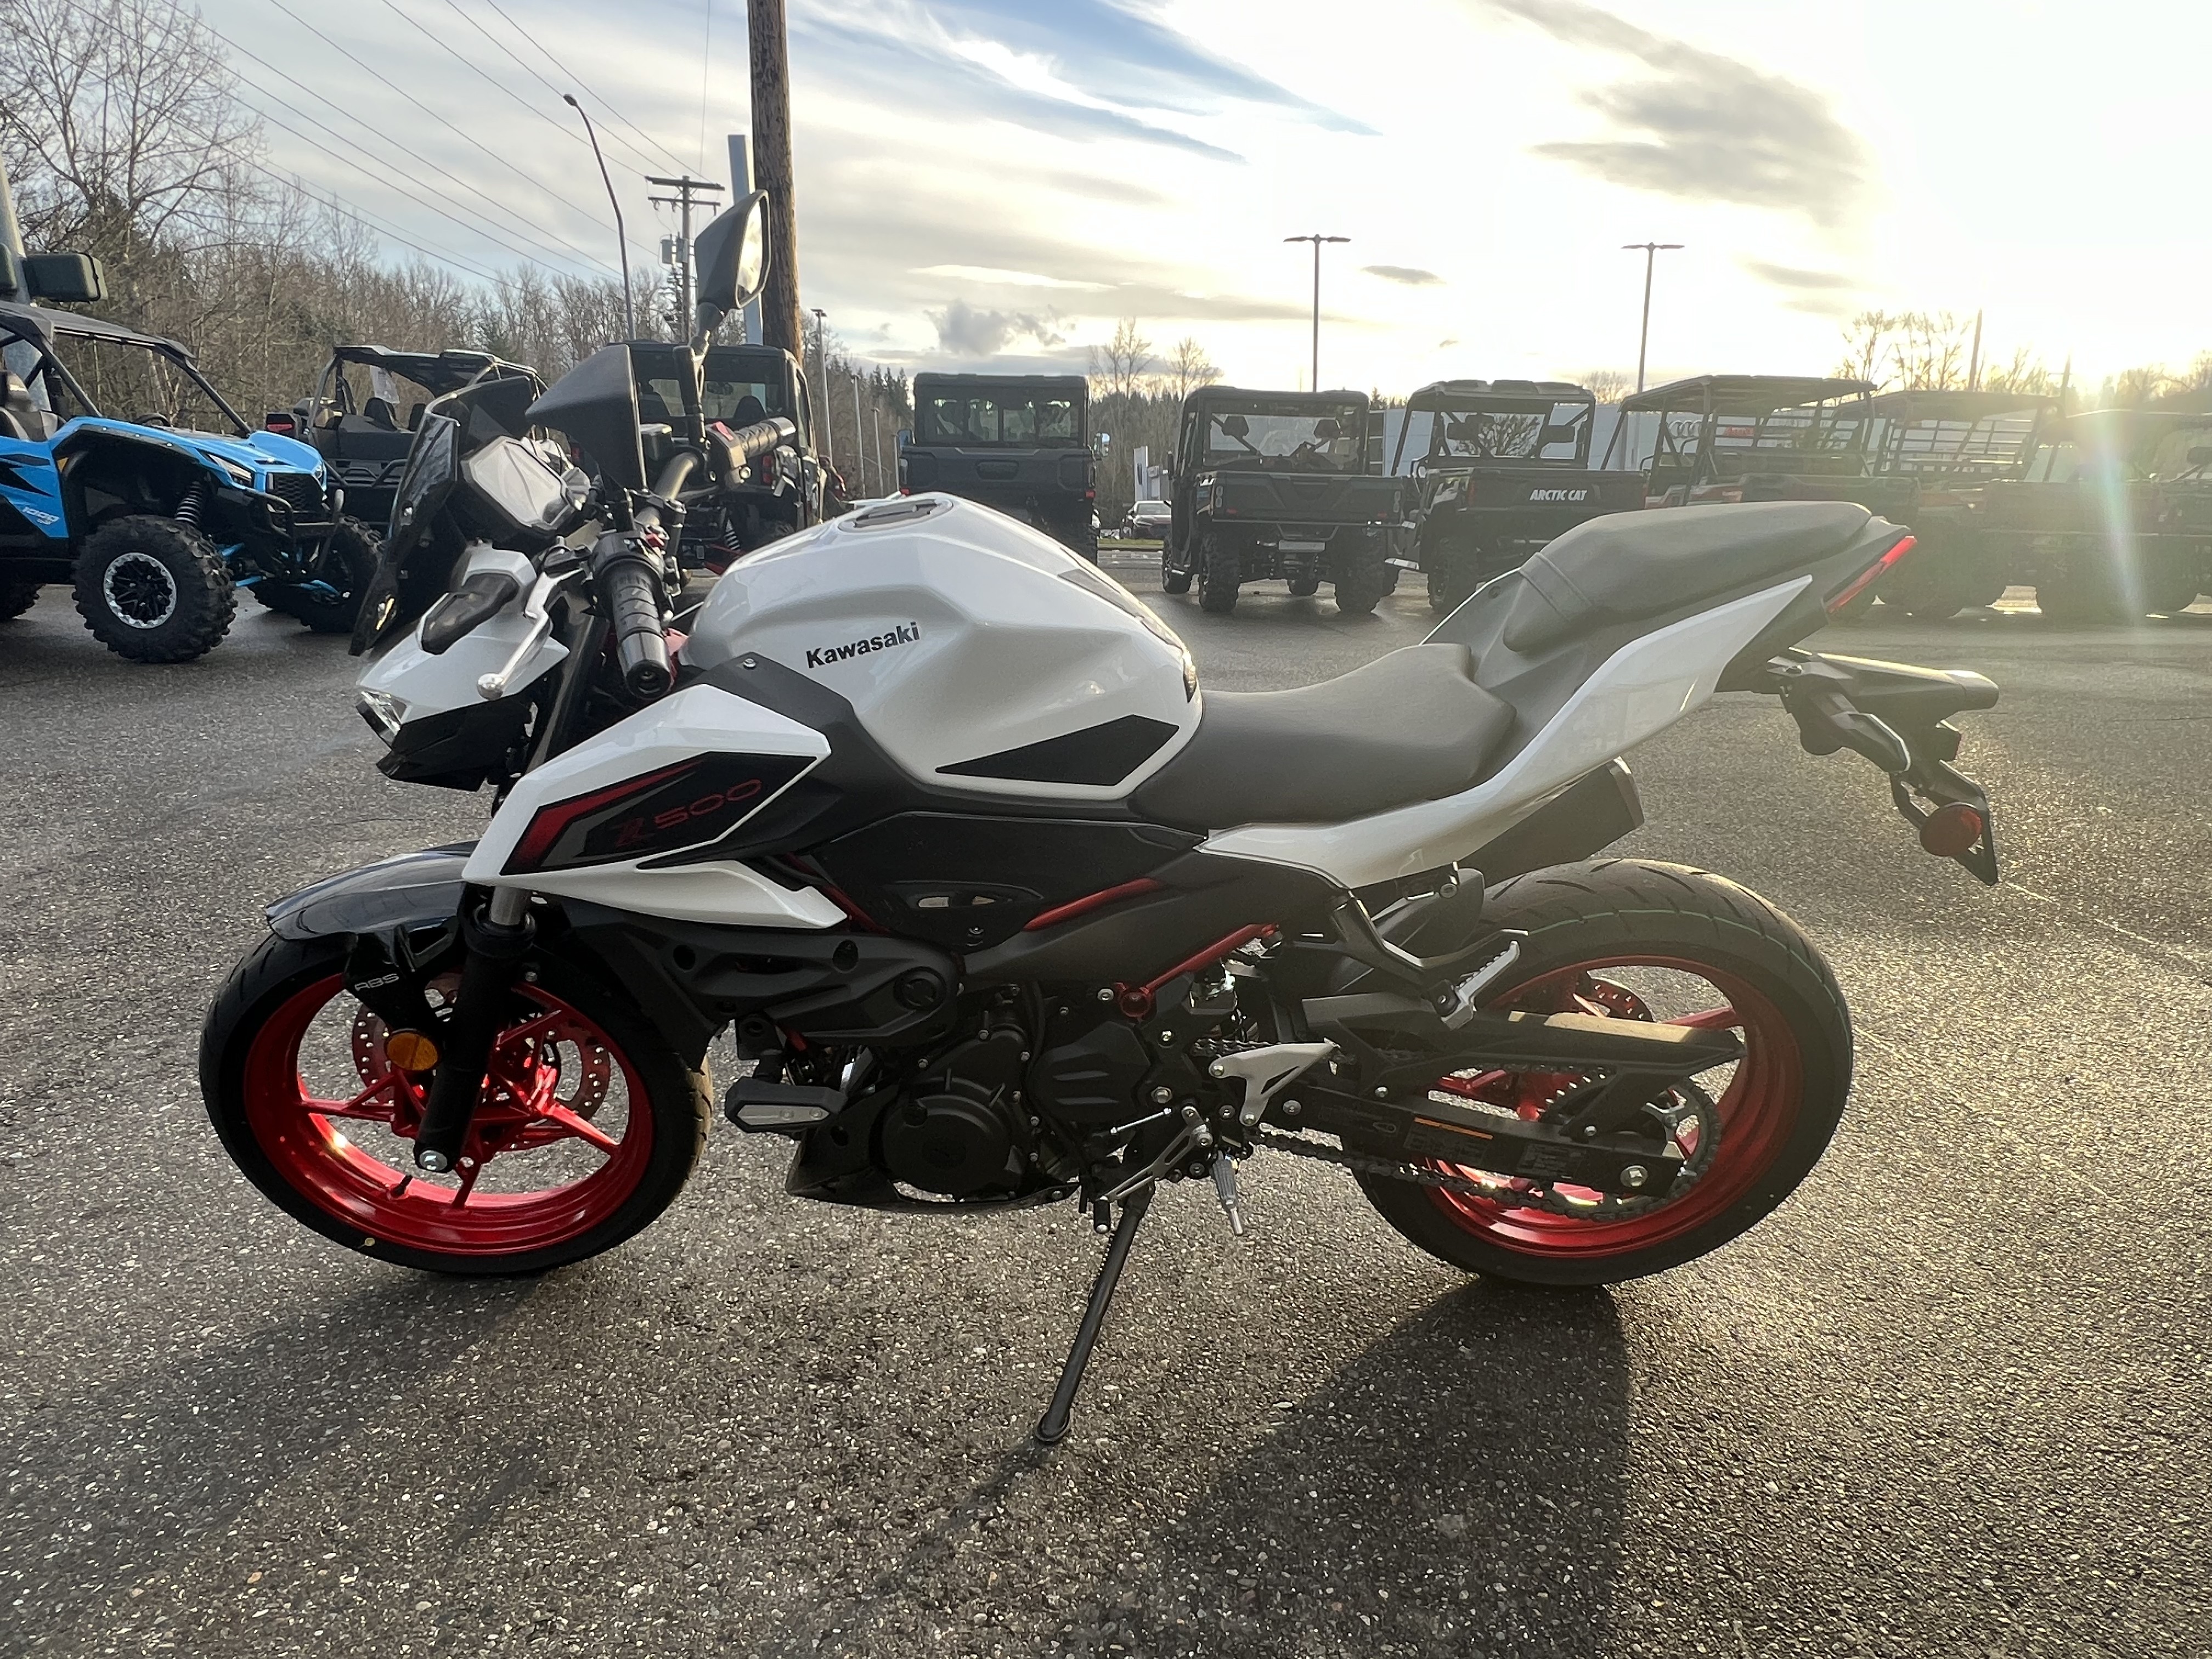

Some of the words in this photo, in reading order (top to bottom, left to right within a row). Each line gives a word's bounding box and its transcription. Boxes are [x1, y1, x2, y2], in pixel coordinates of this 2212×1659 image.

[1529, 489, 1568, 500] ARCTIC
[1568, 489, 1588, 500] CAT
[806, 621, 920, 668] Kawasaki
[354, 973, 399, 991] ABS
